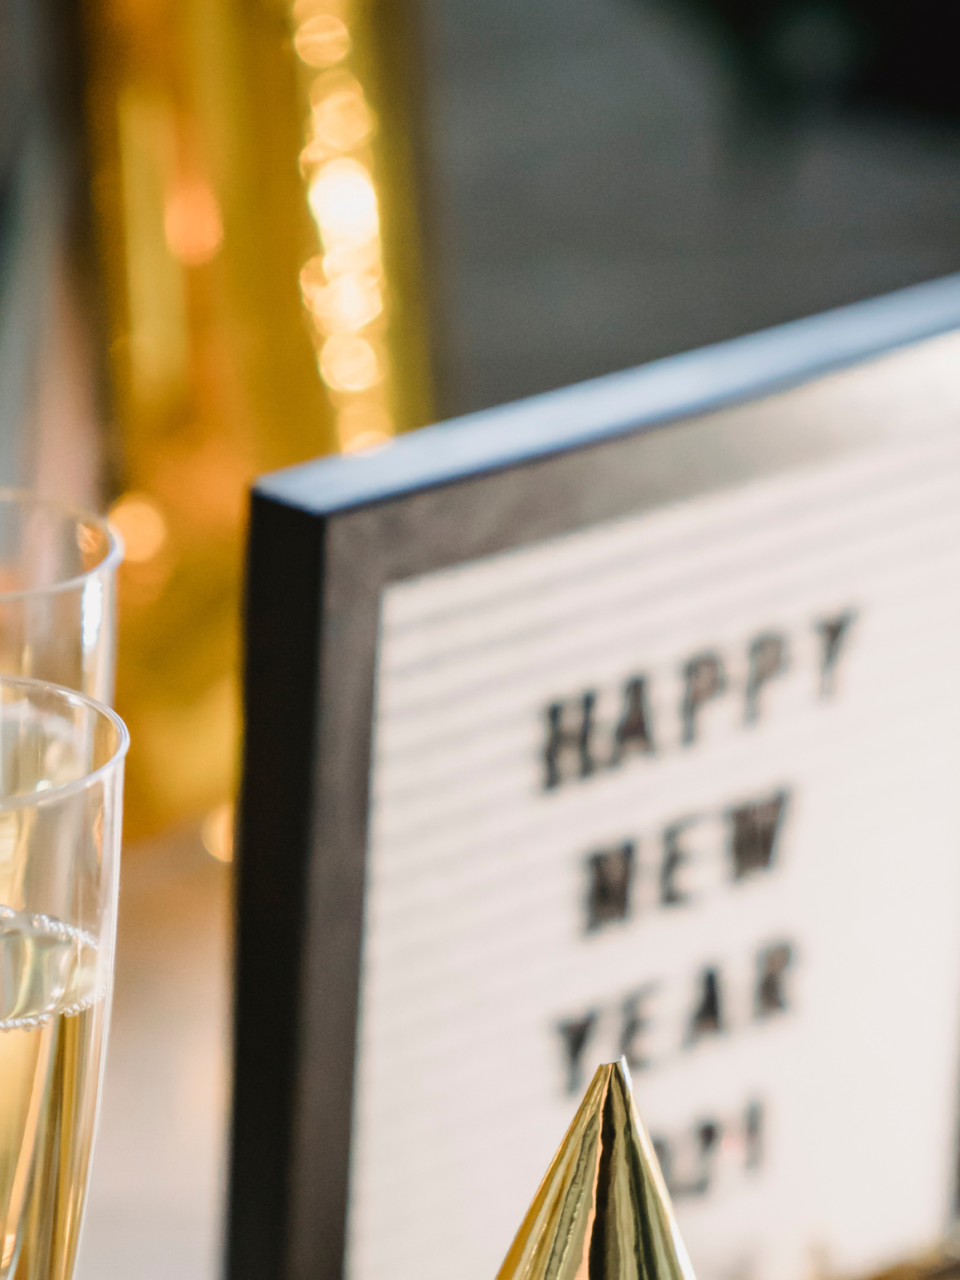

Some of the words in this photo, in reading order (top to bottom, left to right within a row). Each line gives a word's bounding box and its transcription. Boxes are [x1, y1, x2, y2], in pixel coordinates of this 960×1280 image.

[540, 607, 858, 794] HAPPY
[583, 788, 792, 936] NEW
[556, 939, 797, 1096] YEAR
